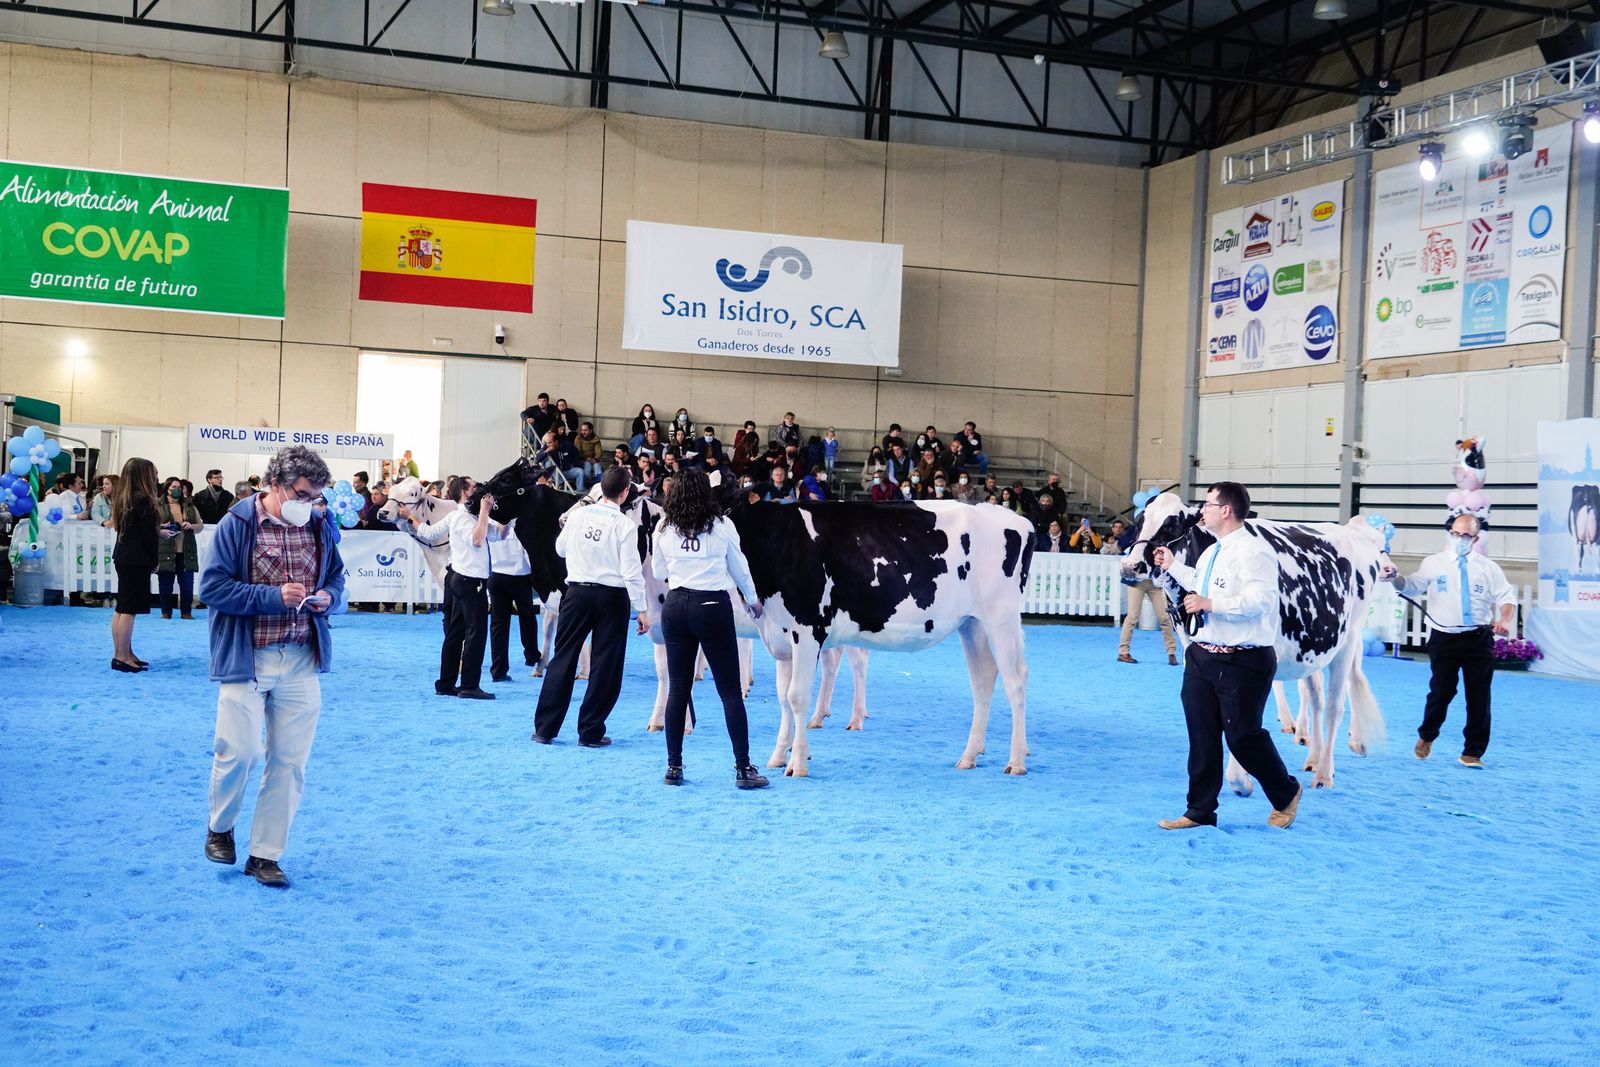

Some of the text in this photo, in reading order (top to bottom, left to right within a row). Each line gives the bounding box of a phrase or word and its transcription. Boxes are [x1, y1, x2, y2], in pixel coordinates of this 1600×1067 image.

[0, 175, 233, 222] Alimentación Animal
[42, 222, 190, 265] COVAP
[1213, 233, 1240, 252] Cargill
[30, 271, 198, 297] garantía de futuro
[1521, 290, 1553, 302] Texigan
[661, 293, 867, 330] San Isidro, SCA
[1395, 298, 1413, 316] bp
[737, 327, 783, 339] Dos Torres
[697, 337, 831, 357] Ganaderos desde 1965
[200, 427, 385, 447] WORLD WIDE SIRES ESPAÑA
[584, 526, 602, 542] 38
[680, 537, 701, 552] 40
[357, 567, 374, 577] San
[377, 568, 405, 579] Isidro,
[1214, 577, 1226, 589] 42
